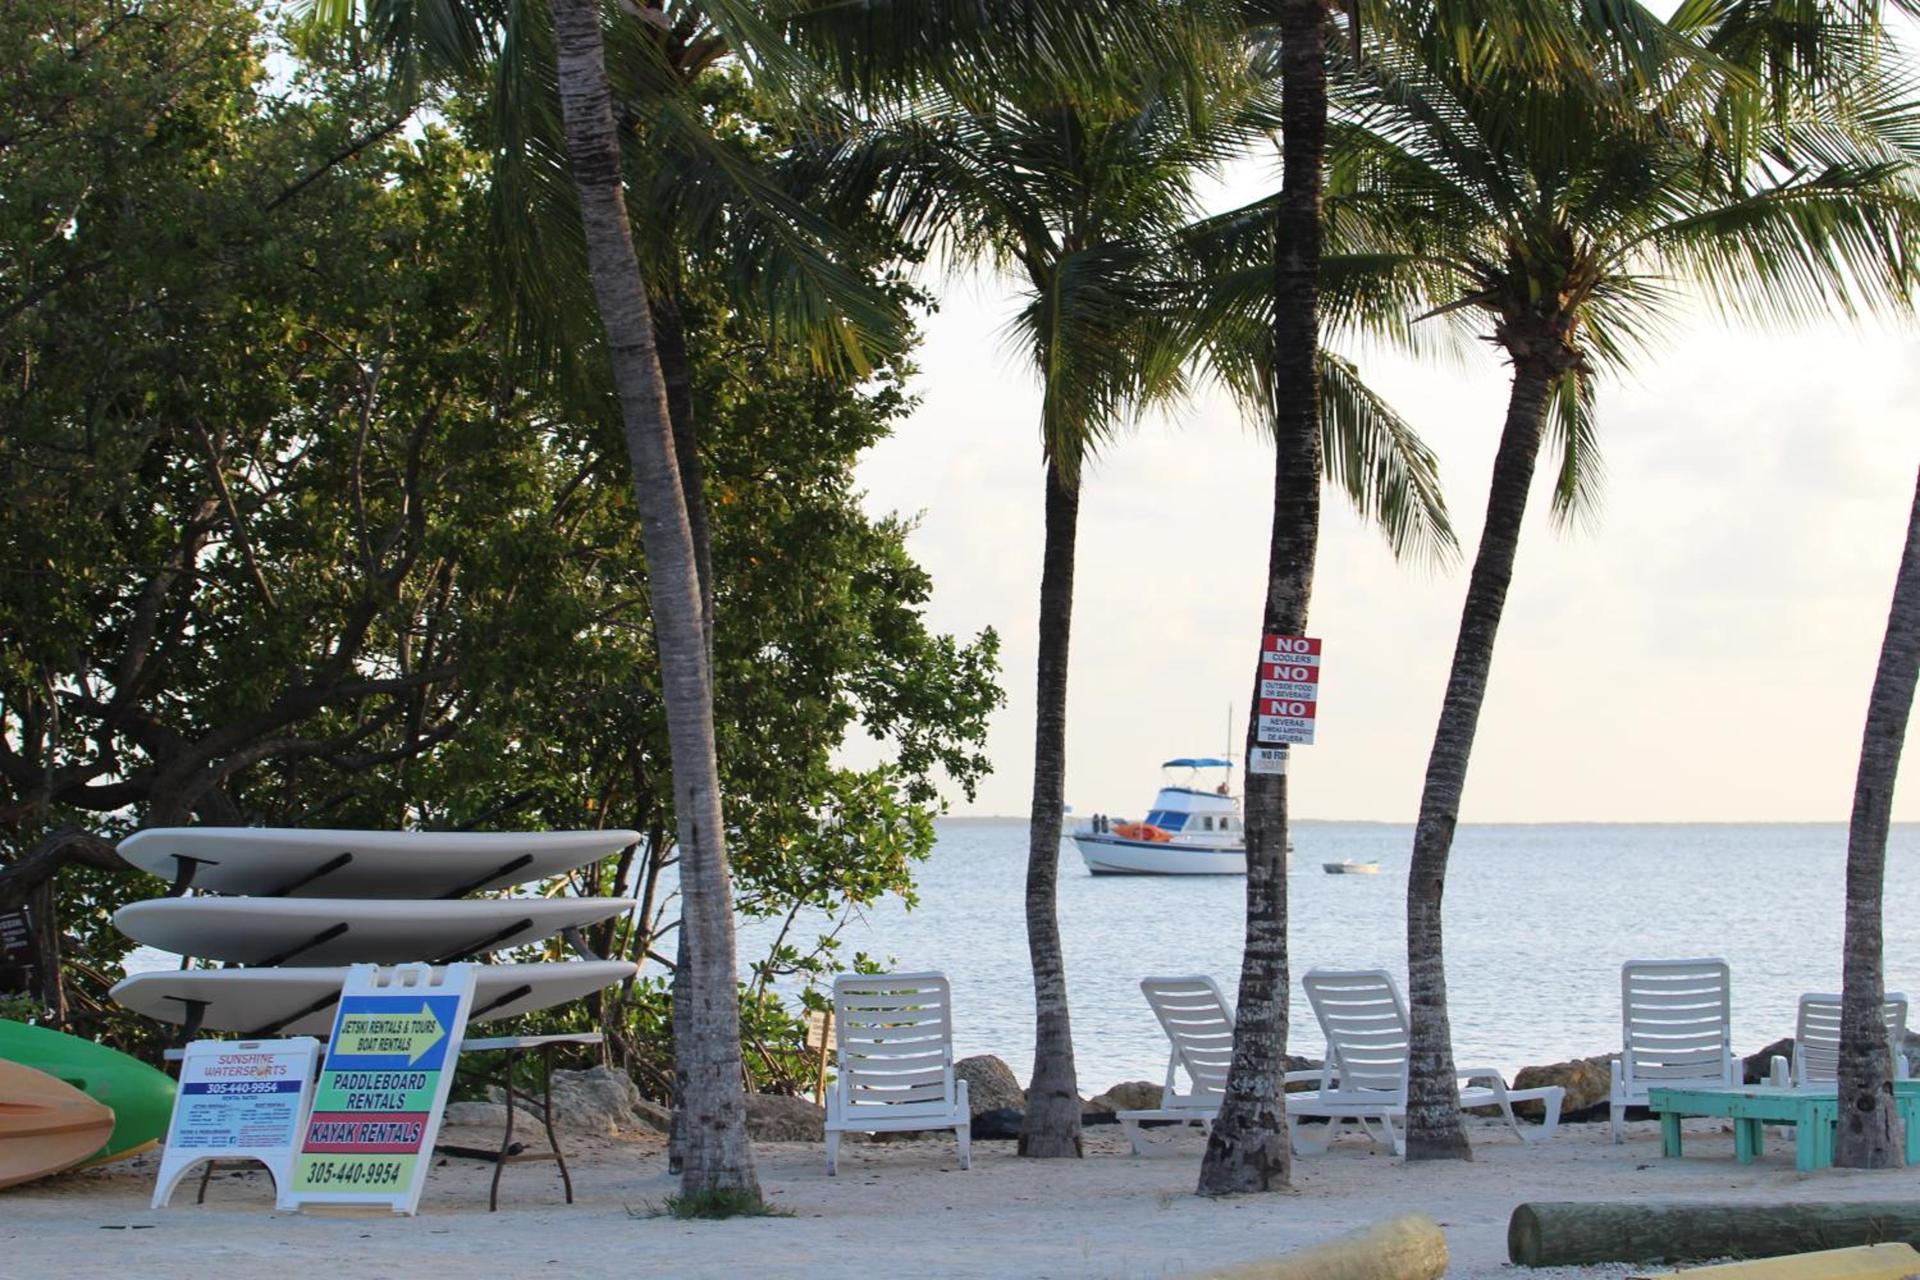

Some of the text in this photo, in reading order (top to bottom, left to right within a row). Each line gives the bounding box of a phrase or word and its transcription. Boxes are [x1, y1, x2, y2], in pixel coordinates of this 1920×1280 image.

[1277, 639, 1309, 653] NO
[1272, 654, 1311, 663] COOLERS
[1274, 666, 1308, 680] NO
[1265, 682, 1312, 692] OUTSIDE FOOD
[1265, 689, 1311, 699] OR BEVERAGE
[1271, 701, 1305, 715] NO
[1270, 719, 1304, 727] NEVERAS
[342, 1020, 436, 1034] JETSKI RENTALS & TOURS
[356, 1037, 412, 1051] BOAT RENTALS
[218, 1054, 275, 1064] SUNSHINE
[207, 1083, 277, 1093] 305-440-9954
[333, 1073, 426, 1090] PADDLEBOARD
[346, 1093, 406, 1110] RENTALS
[309, 1123, 356, 1144] KAYAK
[357, 1122, 421, 1144] RENTALS
[308, 1162, 400, 1184] 305-440-9954
